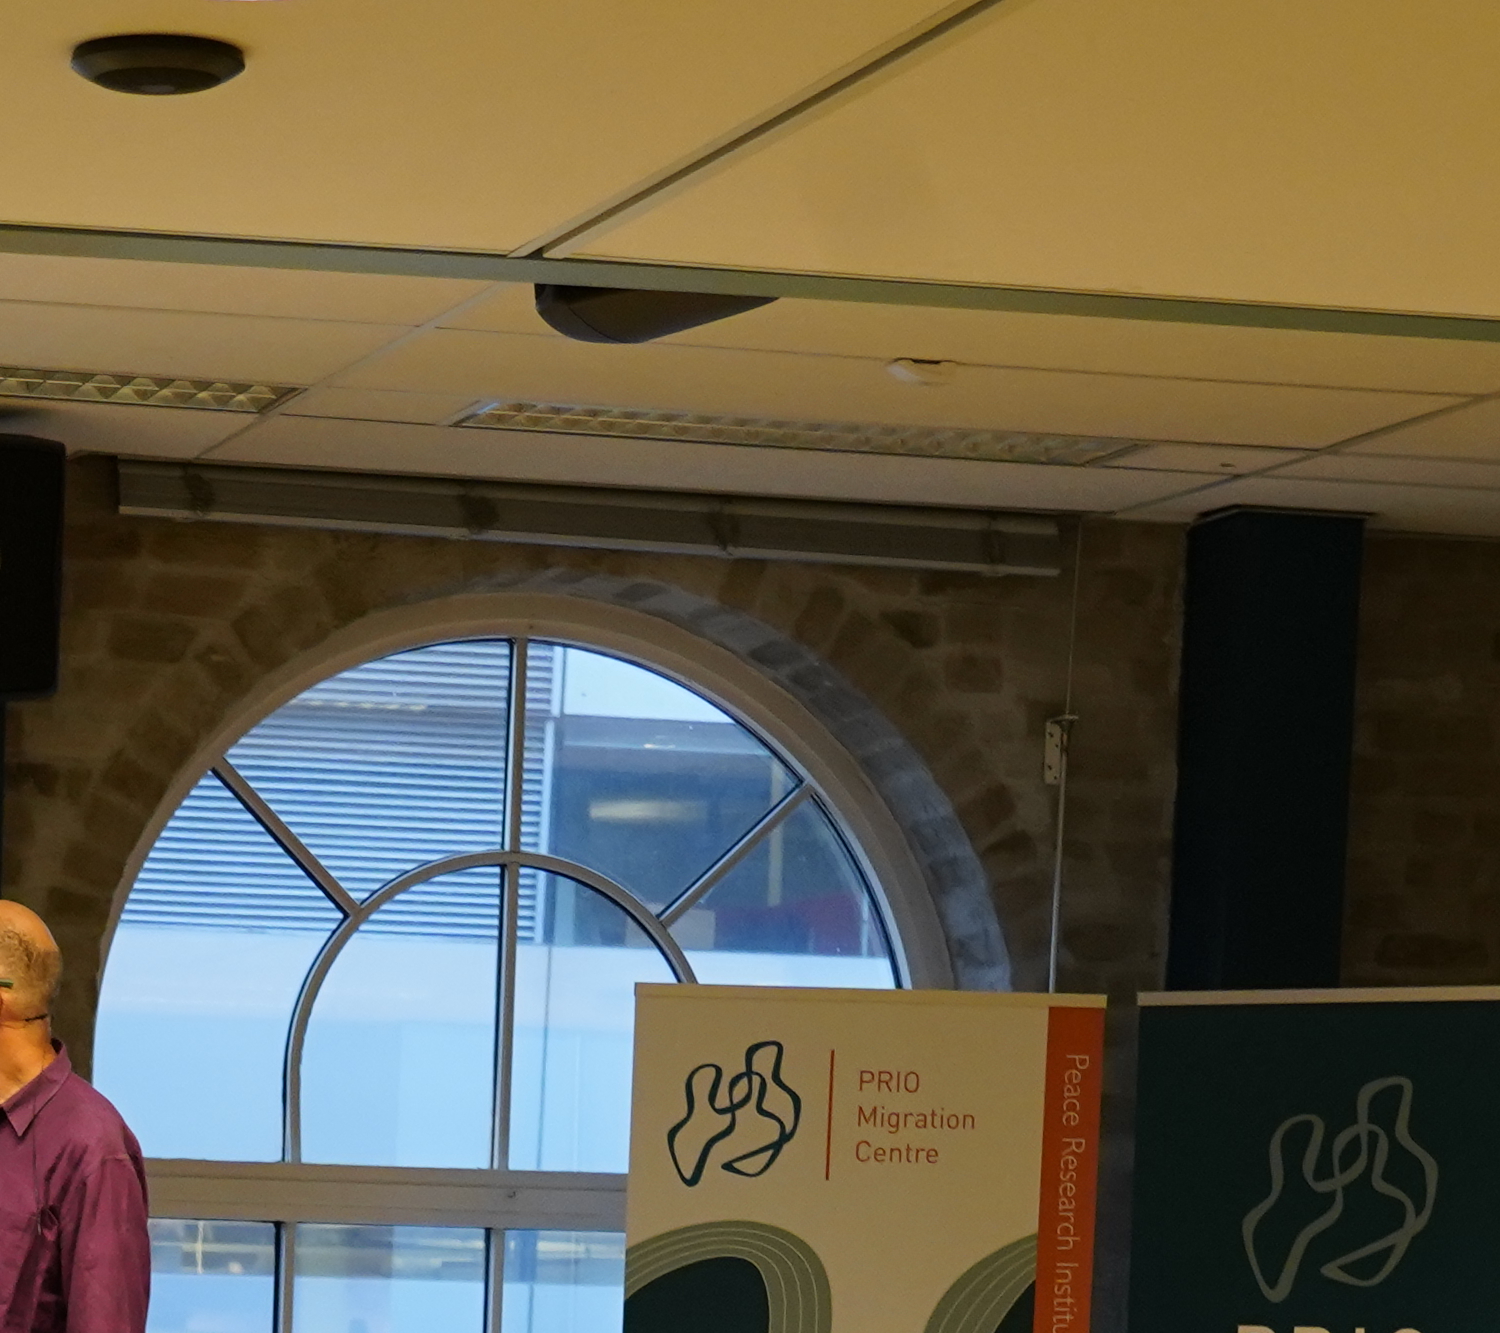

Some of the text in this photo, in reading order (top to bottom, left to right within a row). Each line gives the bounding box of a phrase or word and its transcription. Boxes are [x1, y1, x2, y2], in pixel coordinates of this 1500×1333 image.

[859, 1070, 921, 1094] PRIO
[1065, 1053, 1090, 1126] Peace
[857, 1105, 976, 1134] Migration
[855, 1140, 939, 1165] Centre
[1056, 1137, 1086, 1252] Research
